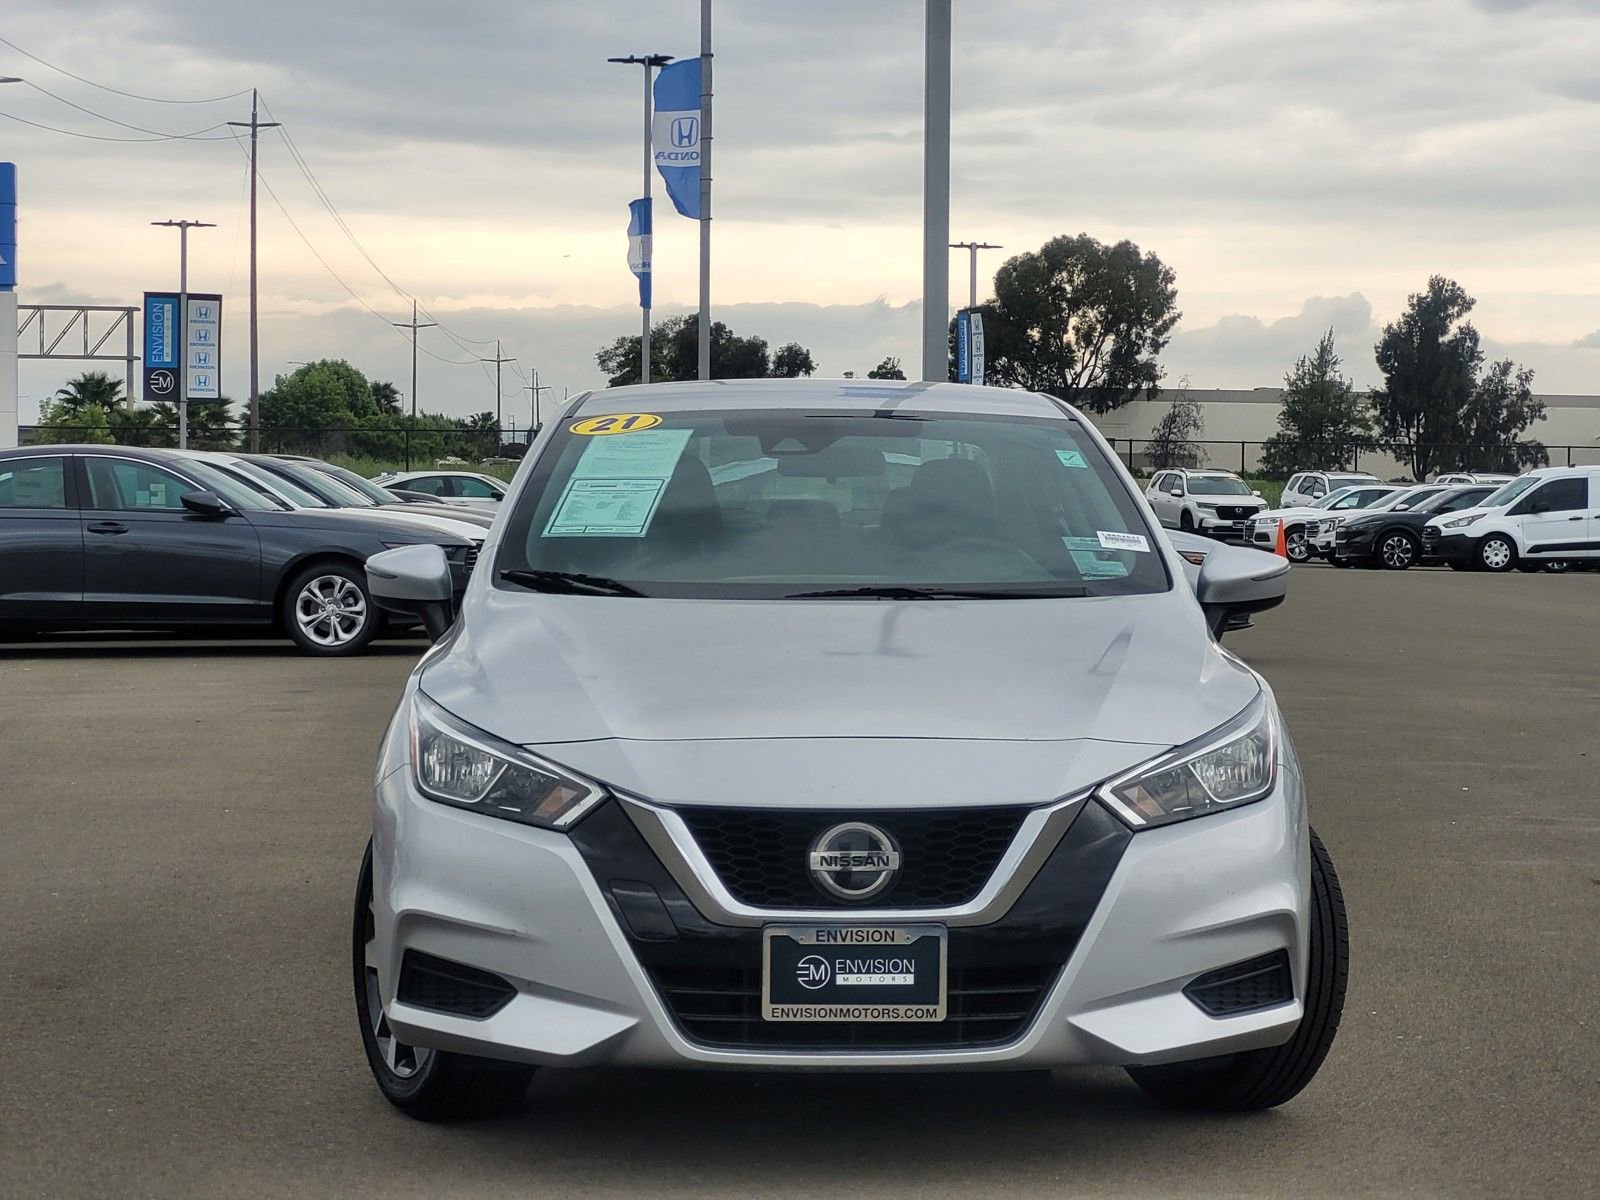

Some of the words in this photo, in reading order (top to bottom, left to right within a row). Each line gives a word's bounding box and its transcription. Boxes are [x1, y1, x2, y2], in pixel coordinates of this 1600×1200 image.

[152, 303, 164, 362] ENVISION
[588, 415, 640, 432] 21
[820, 854, 890, 868] NISSAN
[815, 929, 896, 943] ENVISION
[835, 958, 915, 974] ENVISION
[842, 976, 908, 984] MOTORS
[771, 1007, 938, 1020] ENVISIONMOTORS.COM
